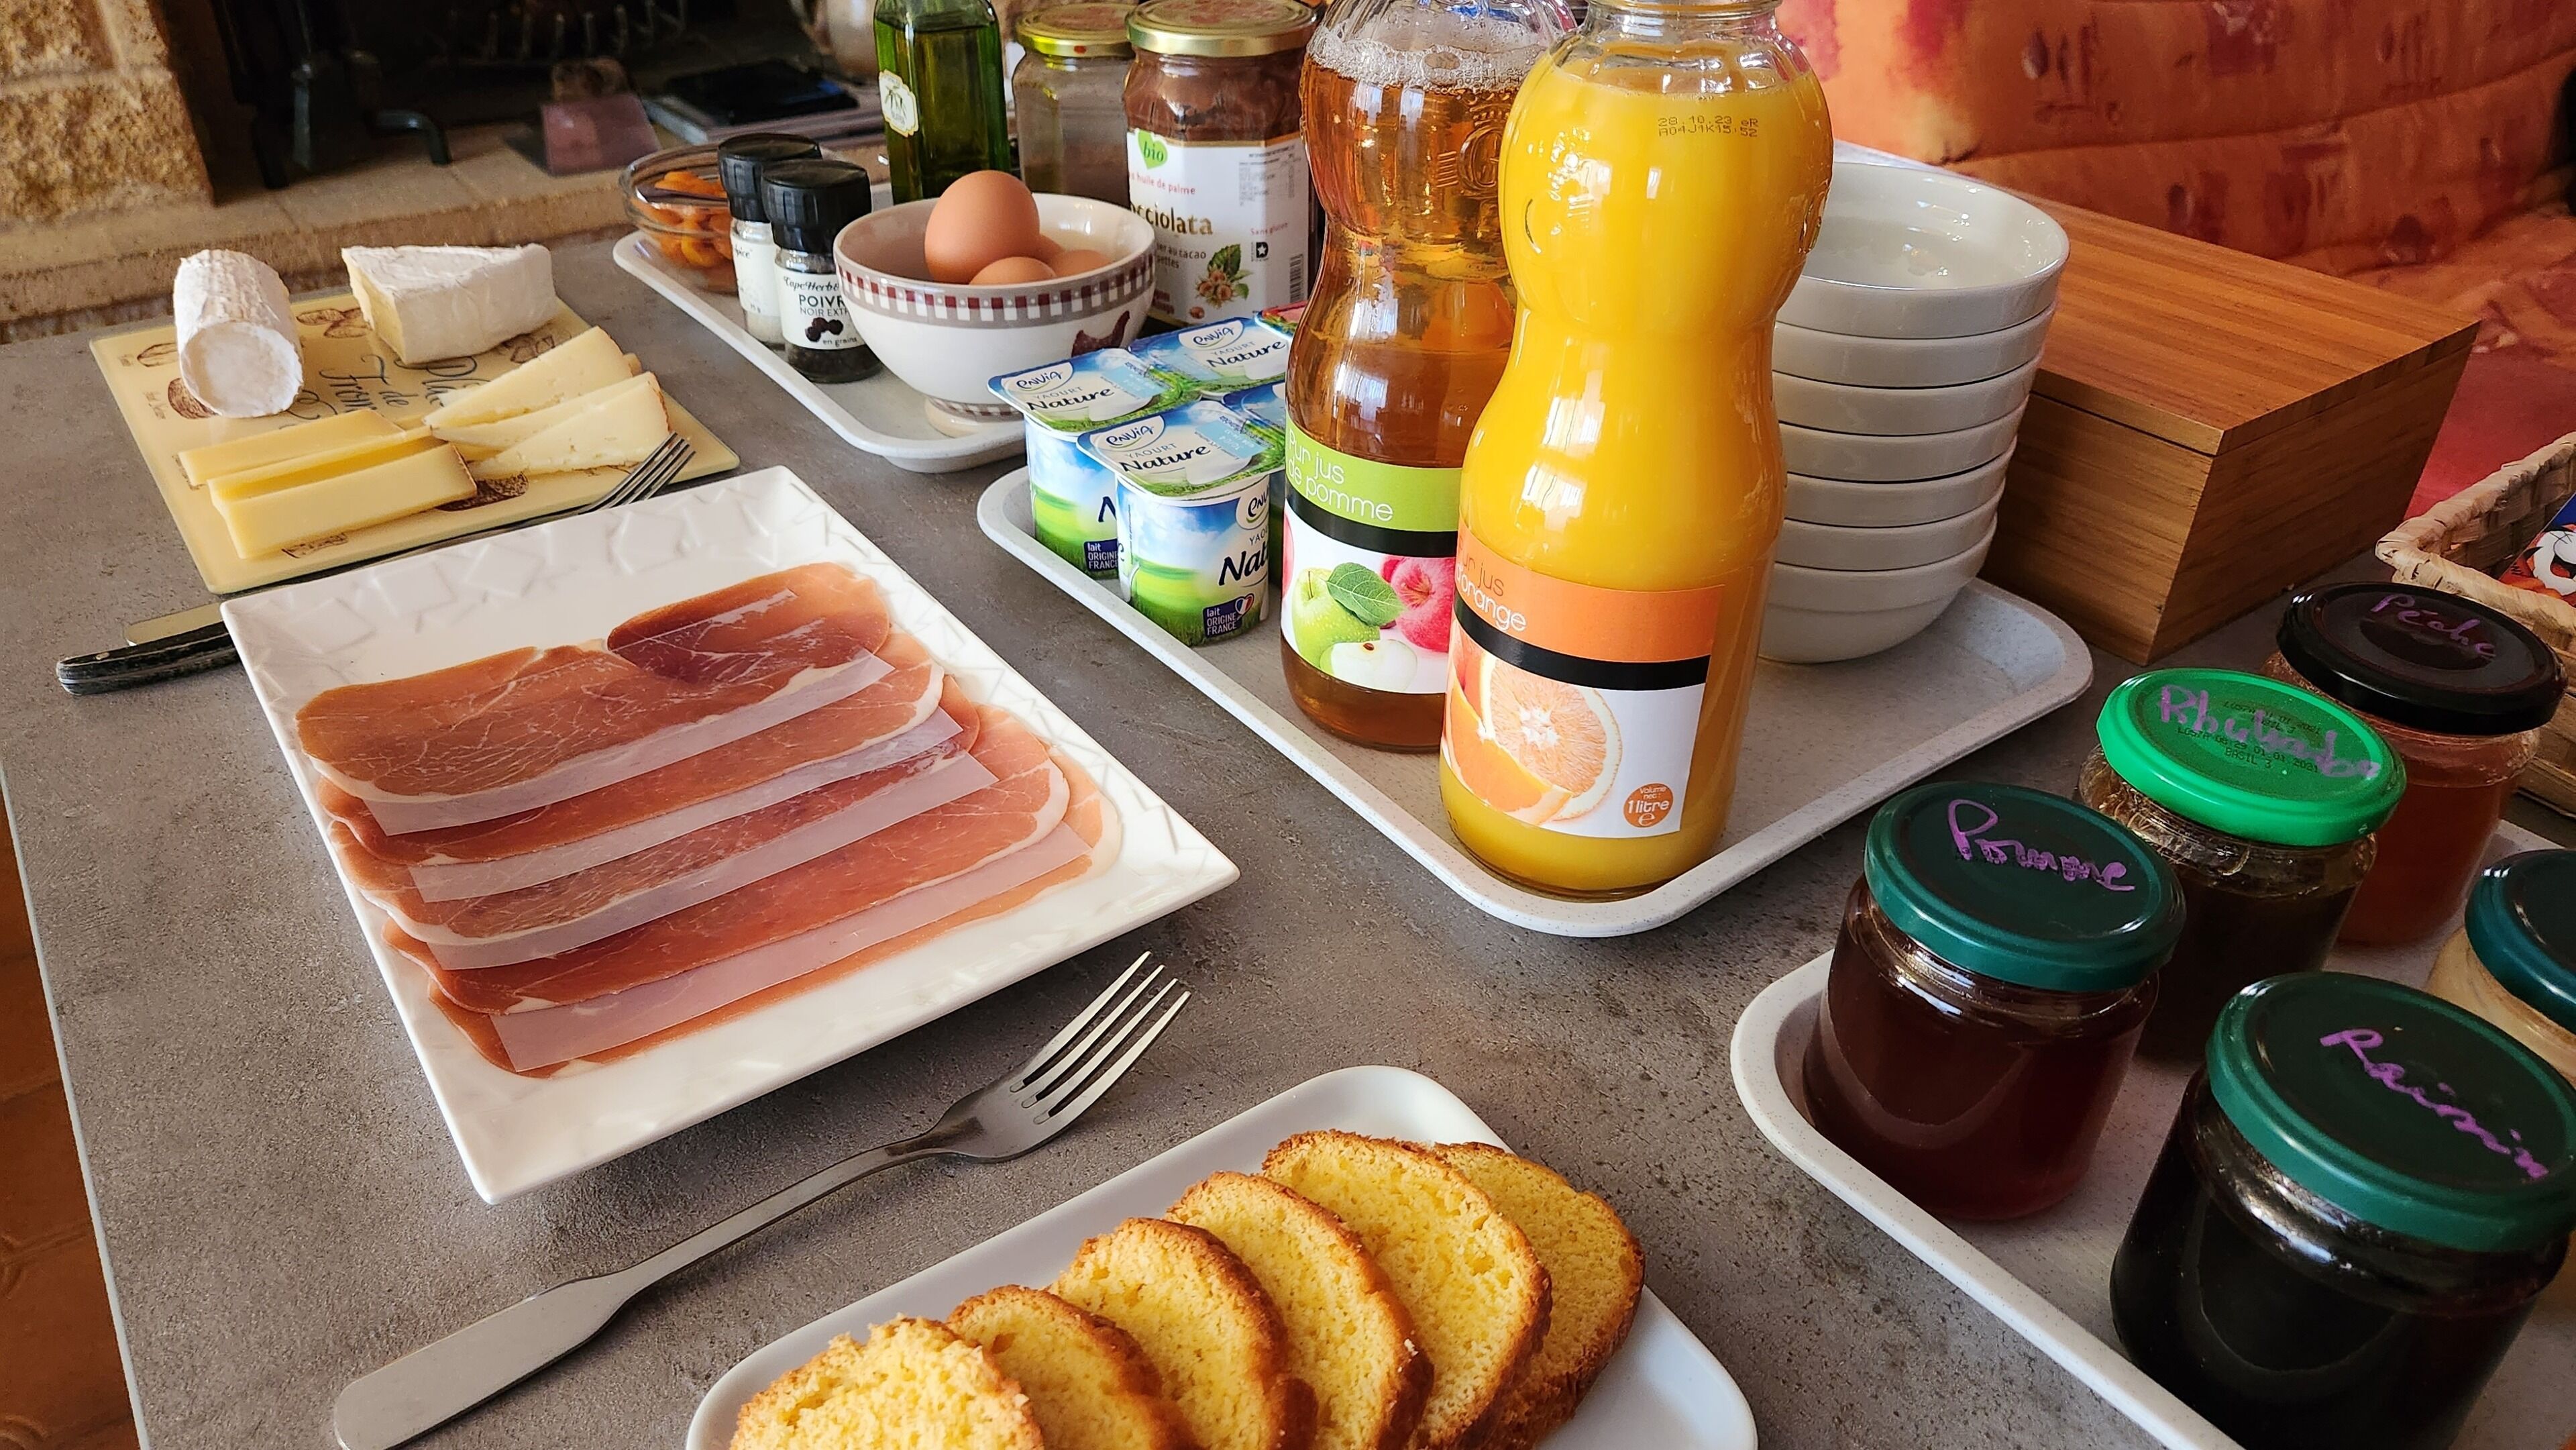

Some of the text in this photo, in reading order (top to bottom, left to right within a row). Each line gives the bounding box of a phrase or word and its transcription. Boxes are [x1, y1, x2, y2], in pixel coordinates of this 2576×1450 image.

[1143, 140, 1165, 162] bio
[1157, 178, 1166, 189] de
[1168, 183, 1196, 195] palme
[1179, 248, 1207, 259] cacao
[800, 308, 824, 317] NOIR
[1205, 341, 1286, 368] Nature
[1212, 341, 1256, 356] YAOURT
[1026, 388, 1115, 411] Nature
[1033, 386, 1084, 400] YAOURT
[1119, 446, 1211, 472] Nature
[1125, 443, 1177, 459] YAOURT
[1314, 451, 1344, 484] jus
[1288, 456, 1393, 521] de pomme
[1087, 542, 1102, 552] lait
[1478, 562, 1504, 597] jus
[1207, 607, 1220, 617] lait
[1207, 612, 1236, 627] ORIGINE
[1207, 621, 1236, 636] FRANCE
[2224, 747, 2272, 769] BASIL 3
[1635, 800, 1670, 813] litre
